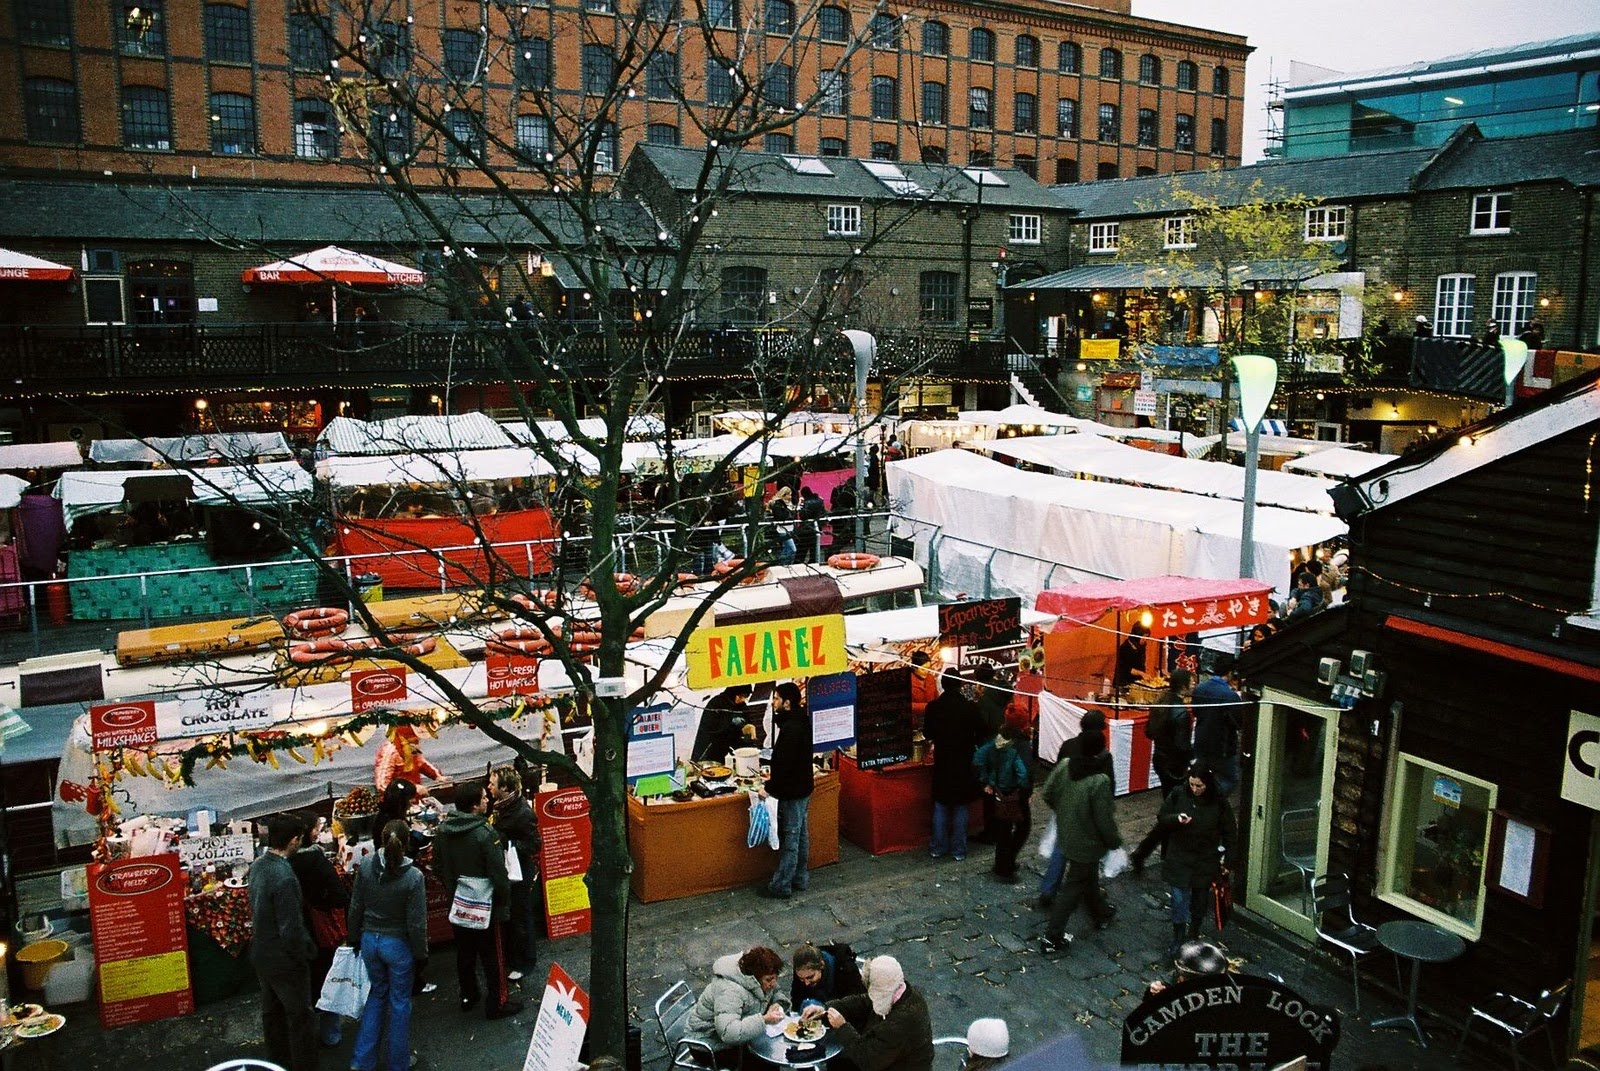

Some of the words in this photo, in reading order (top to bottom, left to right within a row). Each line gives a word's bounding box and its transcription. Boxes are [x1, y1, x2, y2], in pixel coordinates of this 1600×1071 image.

[260, 271, 280, 280] BAR
[387, 273, 423, 283] KITCHEN
[939, 600, 1007, 634] Japanese
[708, 625, 826, 680] FALAFEL
[512, 665, 535, 676] FRESH
[489, 679, 505, 690] HOT
[506, 677, 536, 688] WAFFLES
[205, 697, 240, 711] HOT
[181, 708, 268, 726] CHOCOLATE
[636, 713, 662, 723] ALAFEL
[639, 723, 660, 733] QUEEN
[96, 731, 156, 748] MILKSHAKES
[202, 836, 230, 851] HOT
[185, 847, 244, 861] OCOLATE
[109, 868, 160, 882] STRAWBERRY
[123, 877, 148, 888] FIELDS
[555, 1001, 573, 1027] MENU
[1129, 986, 1244, 1046] CAMDEN
[1266, 990, 1333, 1044] LOCK
[1194, 1032, 1269, 1057] THE
